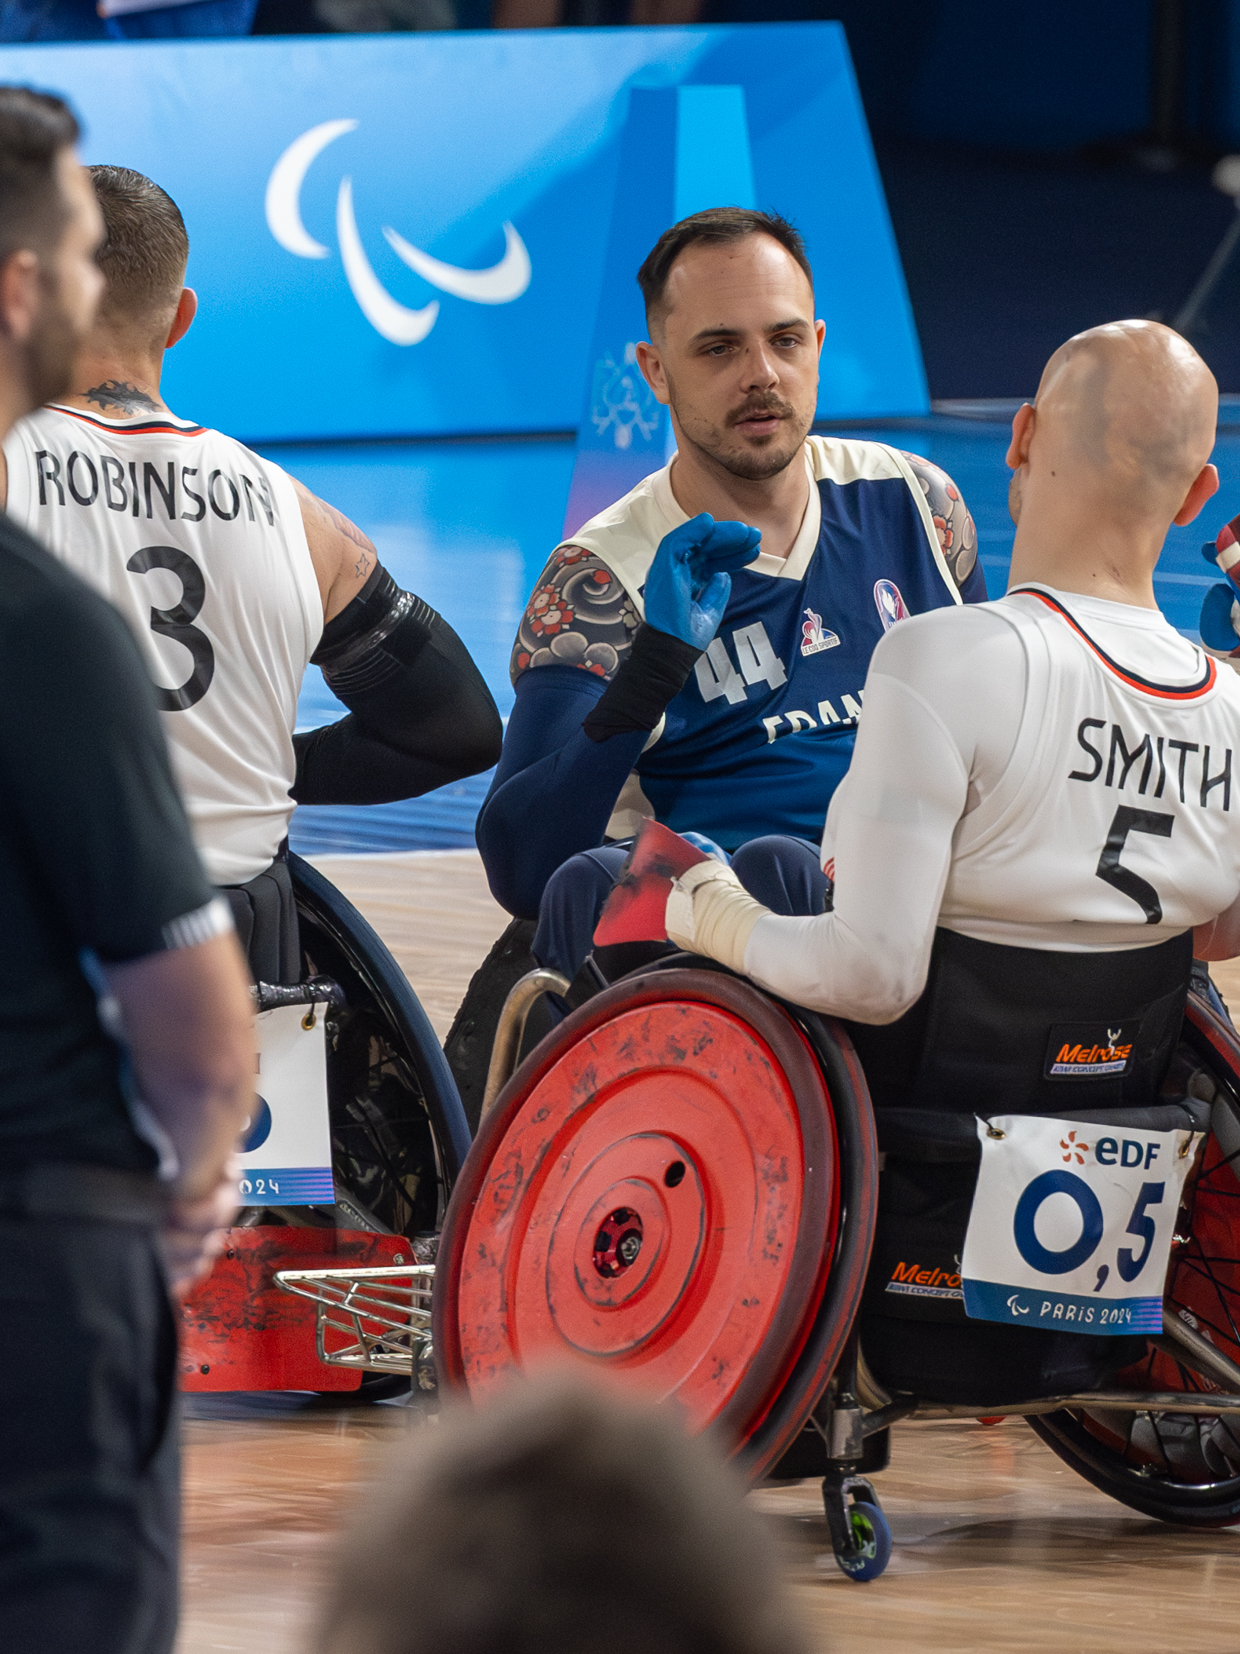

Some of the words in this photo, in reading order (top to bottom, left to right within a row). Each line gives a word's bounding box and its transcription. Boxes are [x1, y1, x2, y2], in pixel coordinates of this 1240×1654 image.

[35, 449, 275, 527] ROBINSON
[126, 545, 215, 712] 3
[694, 621, 788, 705] 44
[802, 646, 809, 655] LE
[1067, 716, 1233, 812] SMITH
[1095, 804, 1175, 925] 5
[1055, 1043, 1133, 1063] Melrose
[238, 1178, 280, 1196] 024
[1013, 1169, 1166, 1293] 0,5
[891, 1261, 962, 1288] Melro
[1040, 1301, 1095, 1323] PARIS
[1099, 1307, 1132, 1324] 2024
